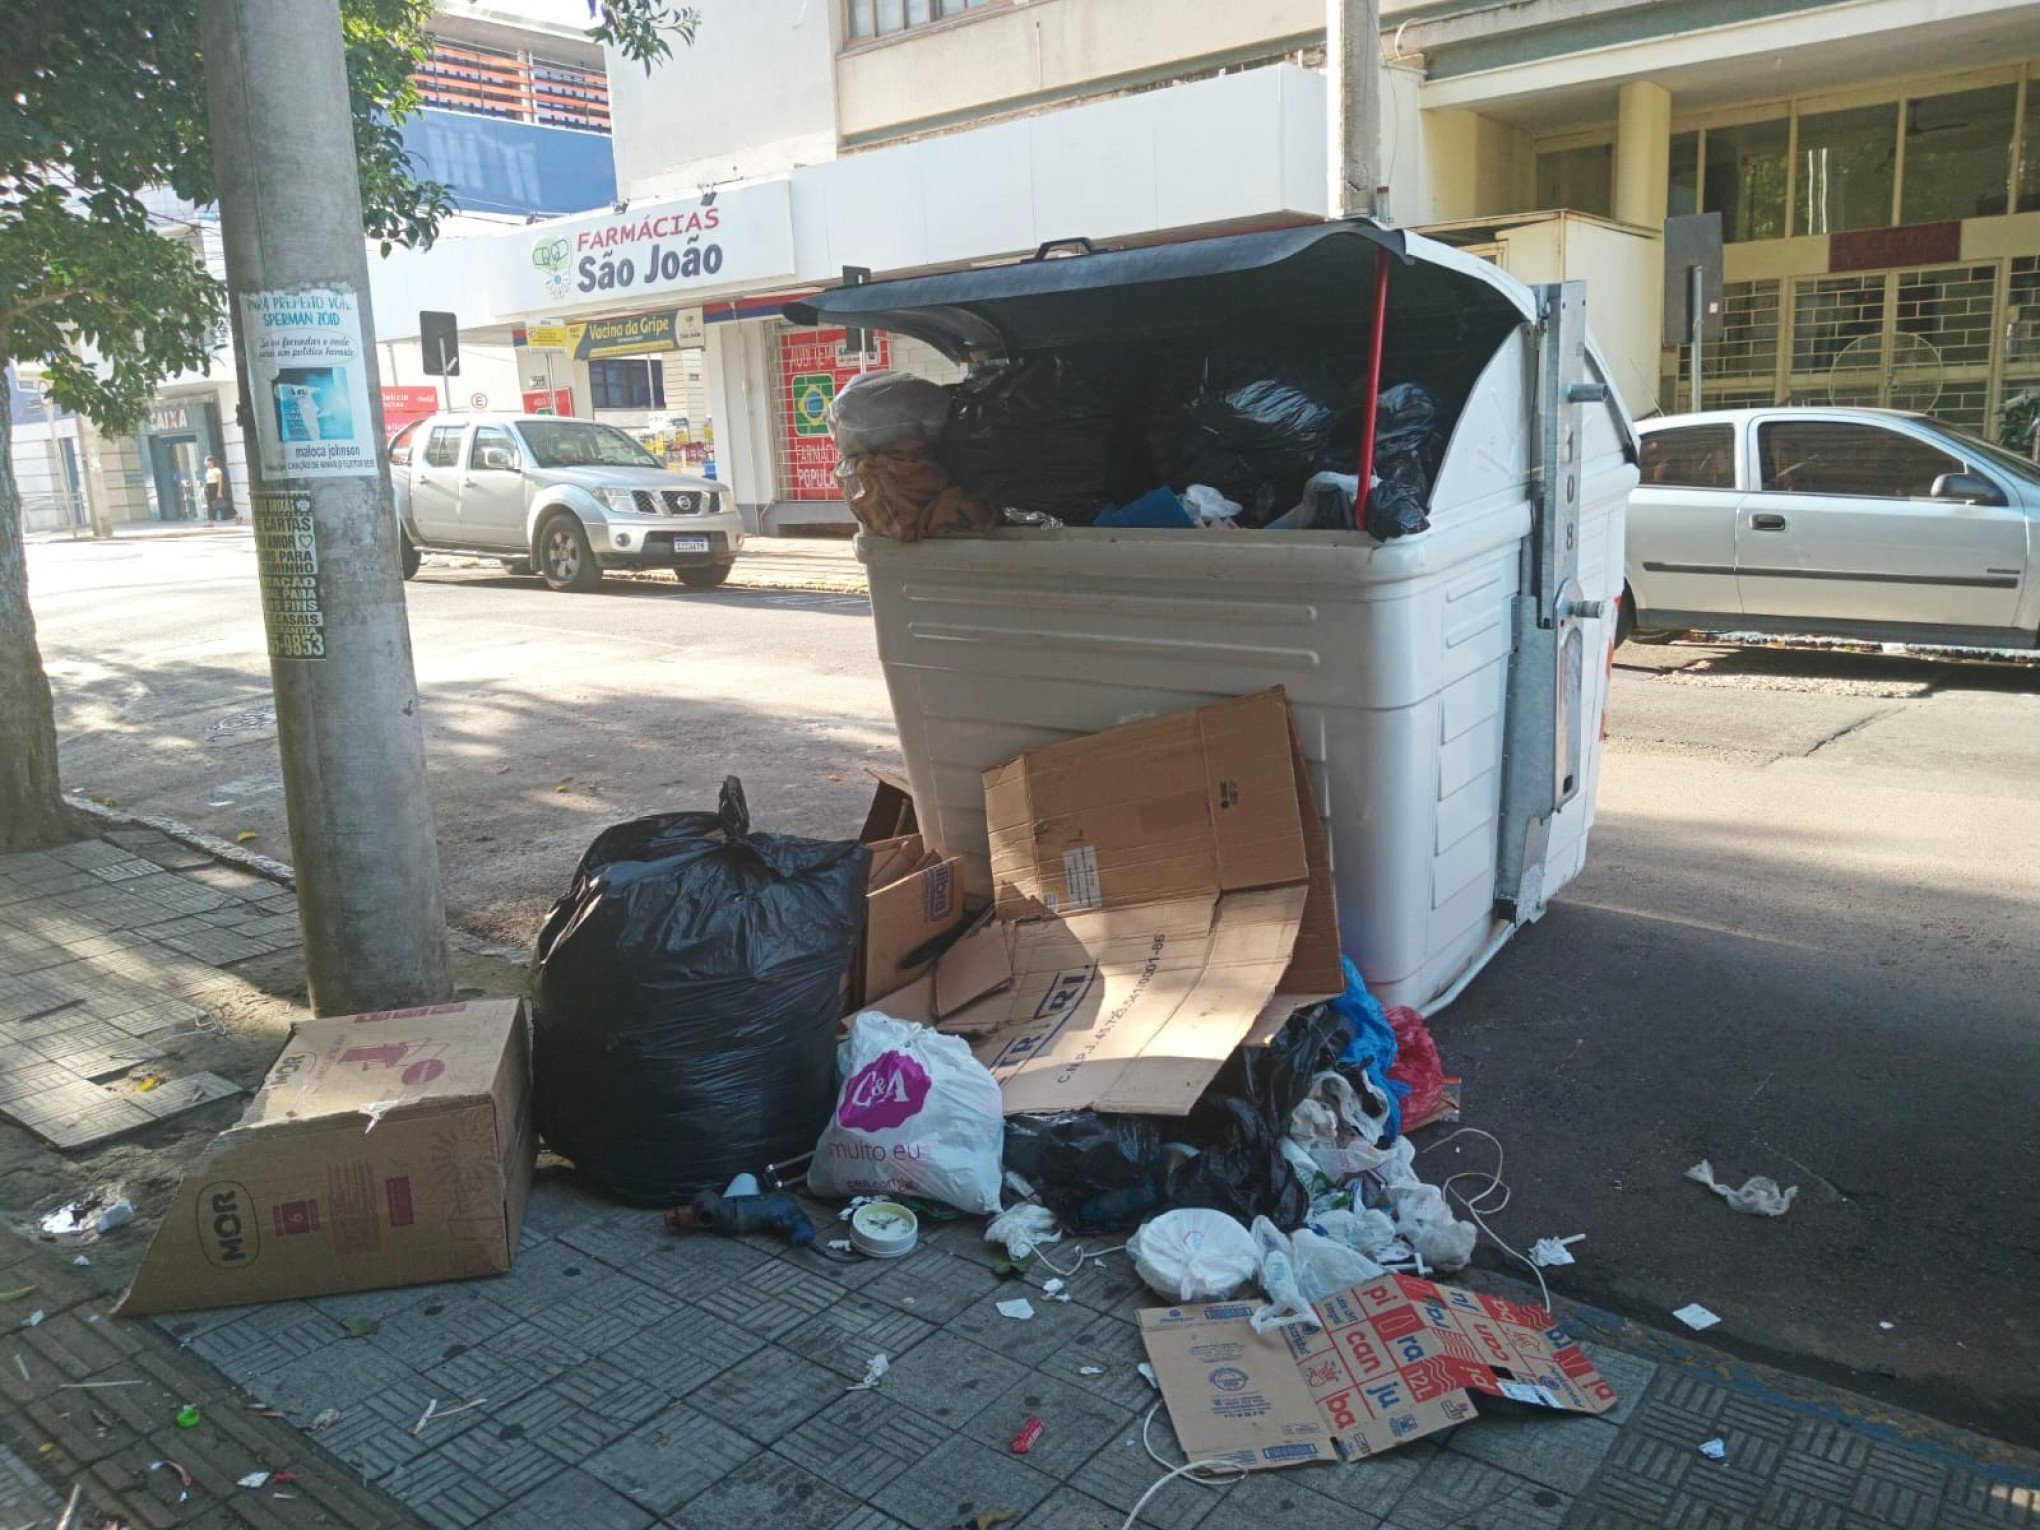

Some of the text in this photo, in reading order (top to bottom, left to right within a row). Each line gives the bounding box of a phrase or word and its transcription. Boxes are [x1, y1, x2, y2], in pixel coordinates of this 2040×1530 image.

[577, 208, 720, 251] FARMÁCIAS
[577, 234, 724, 293] São João
[589, 322, 623, 340] Vacina
[625, 320, 639, 335] da
[640, 316, 670, 336] Gripe
[149, 409, 188, 430] CAIXA
[263, 517, 312, 531] CARTAS
[279, 550, 313, 562] PARA
[283, 588, 317, 599] PARA
[275, 613, 319, 625] CASAIS
[852, 1070, 910, 1107] C&A
[828, 1141, 921, 1162] muito eu
[213, 1189, 246, 1263] MOR
[1363, 1284, 1399, 1307] pi
[1346, 1330, 1382, 1374] can
[1396, 1335, 1425, 1362] ra
[1473, 1323, 1511, 1363] can
[1366, 1381, 1400, 1409] ju
[1326, 1393, 1356, 1430] ba
